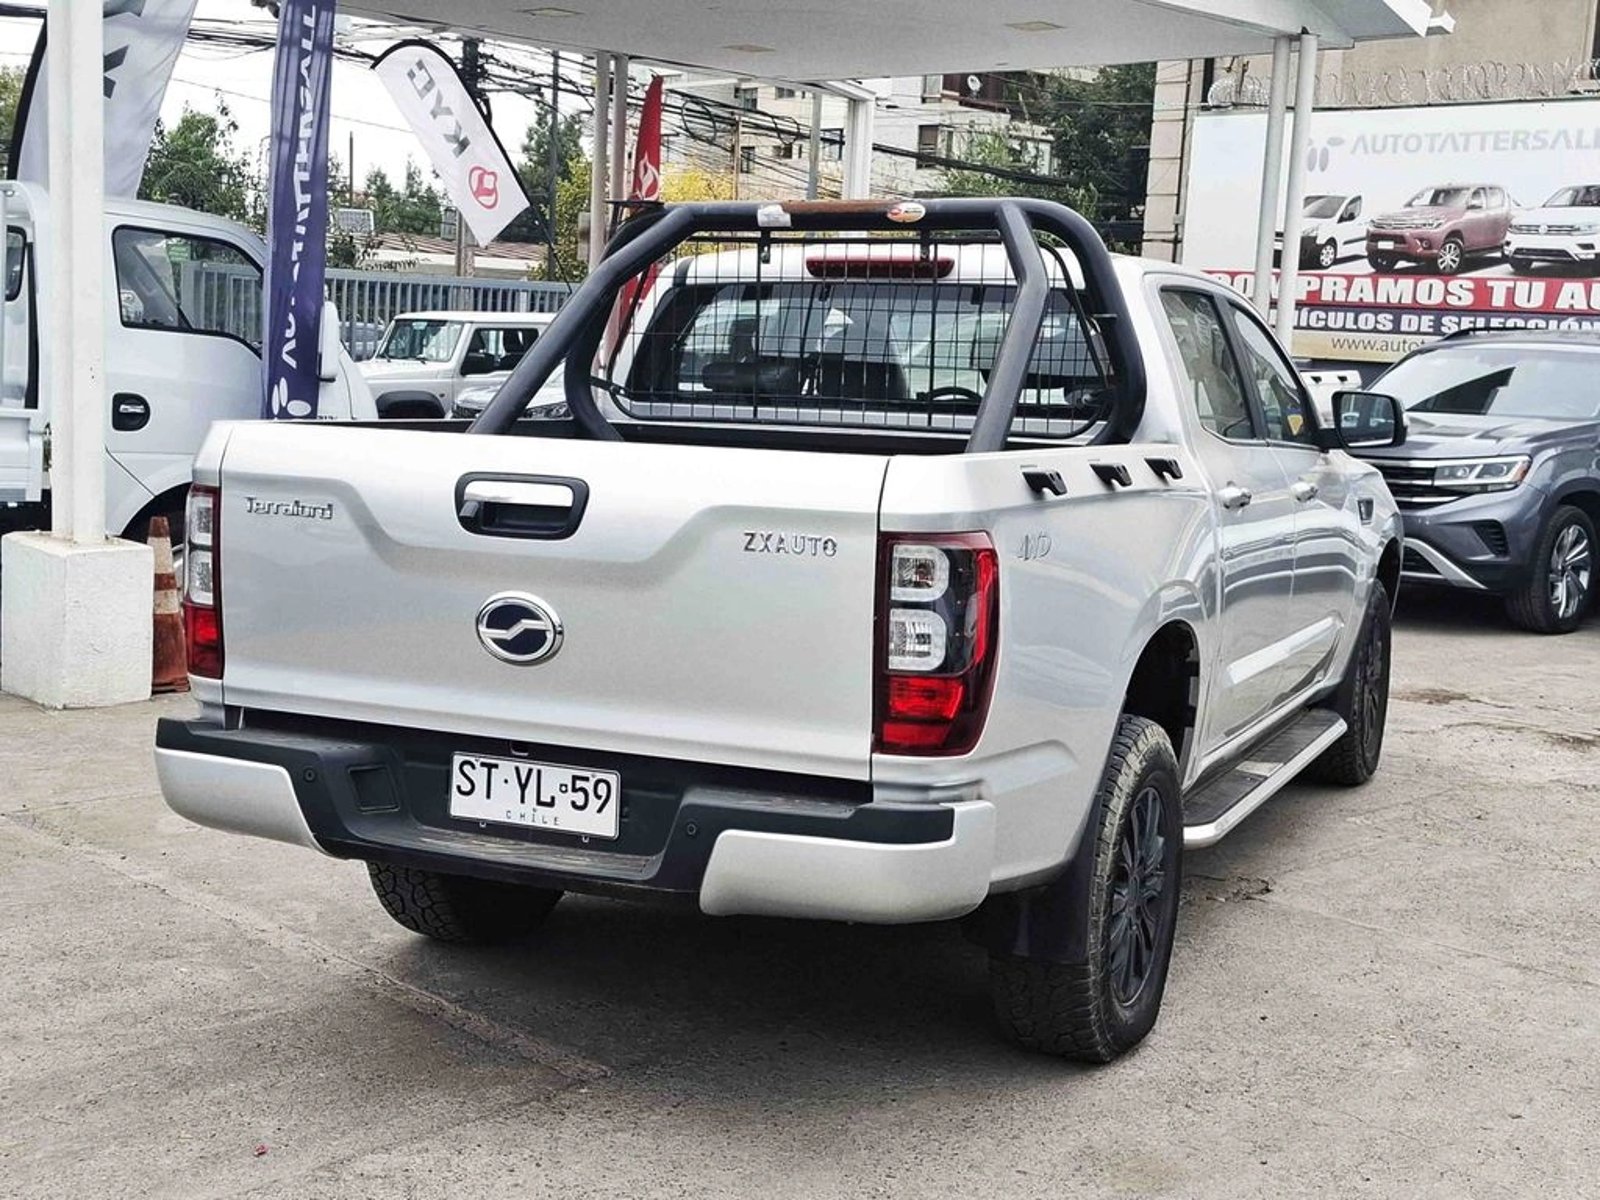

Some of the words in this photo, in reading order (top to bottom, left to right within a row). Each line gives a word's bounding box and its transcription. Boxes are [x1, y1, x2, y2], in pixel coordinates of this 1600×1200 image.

[1487, 279, 1546, 308] TU
[1400, 313, 1434, 333] DE
[743, 531, 839, 558] ZXAUTO
[505, 810, 560, 826] CHILE
